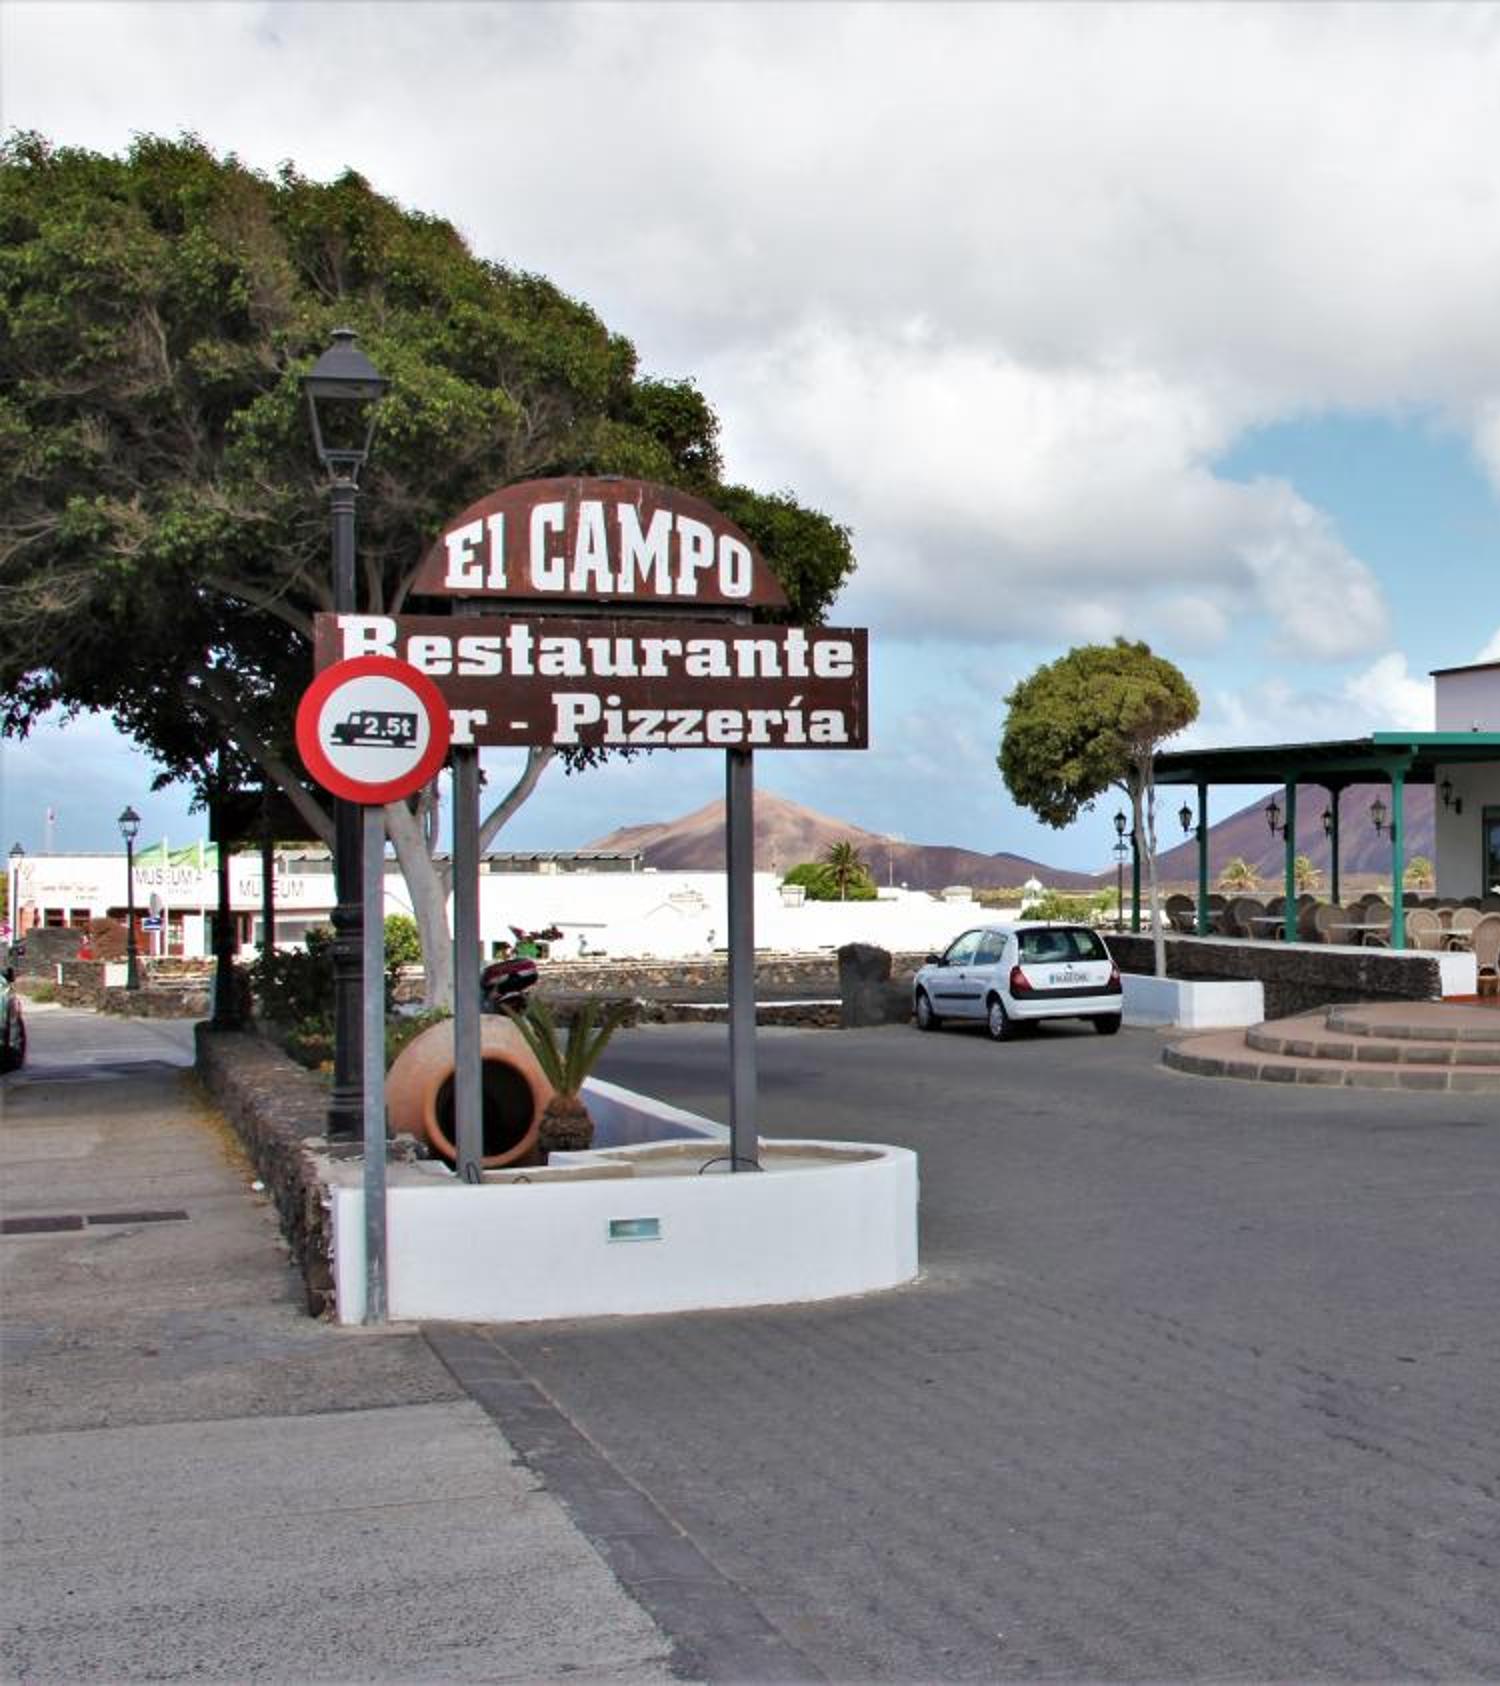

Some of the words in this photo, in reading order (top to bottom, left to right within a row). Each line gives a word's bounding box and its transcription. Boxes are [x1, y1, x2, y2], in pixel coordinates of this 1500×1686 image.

[529, 500, 753, 598] CAMPO
[337, 614, 854, 679] Restaurante
[551, 692, 849, 745] Pizzería
